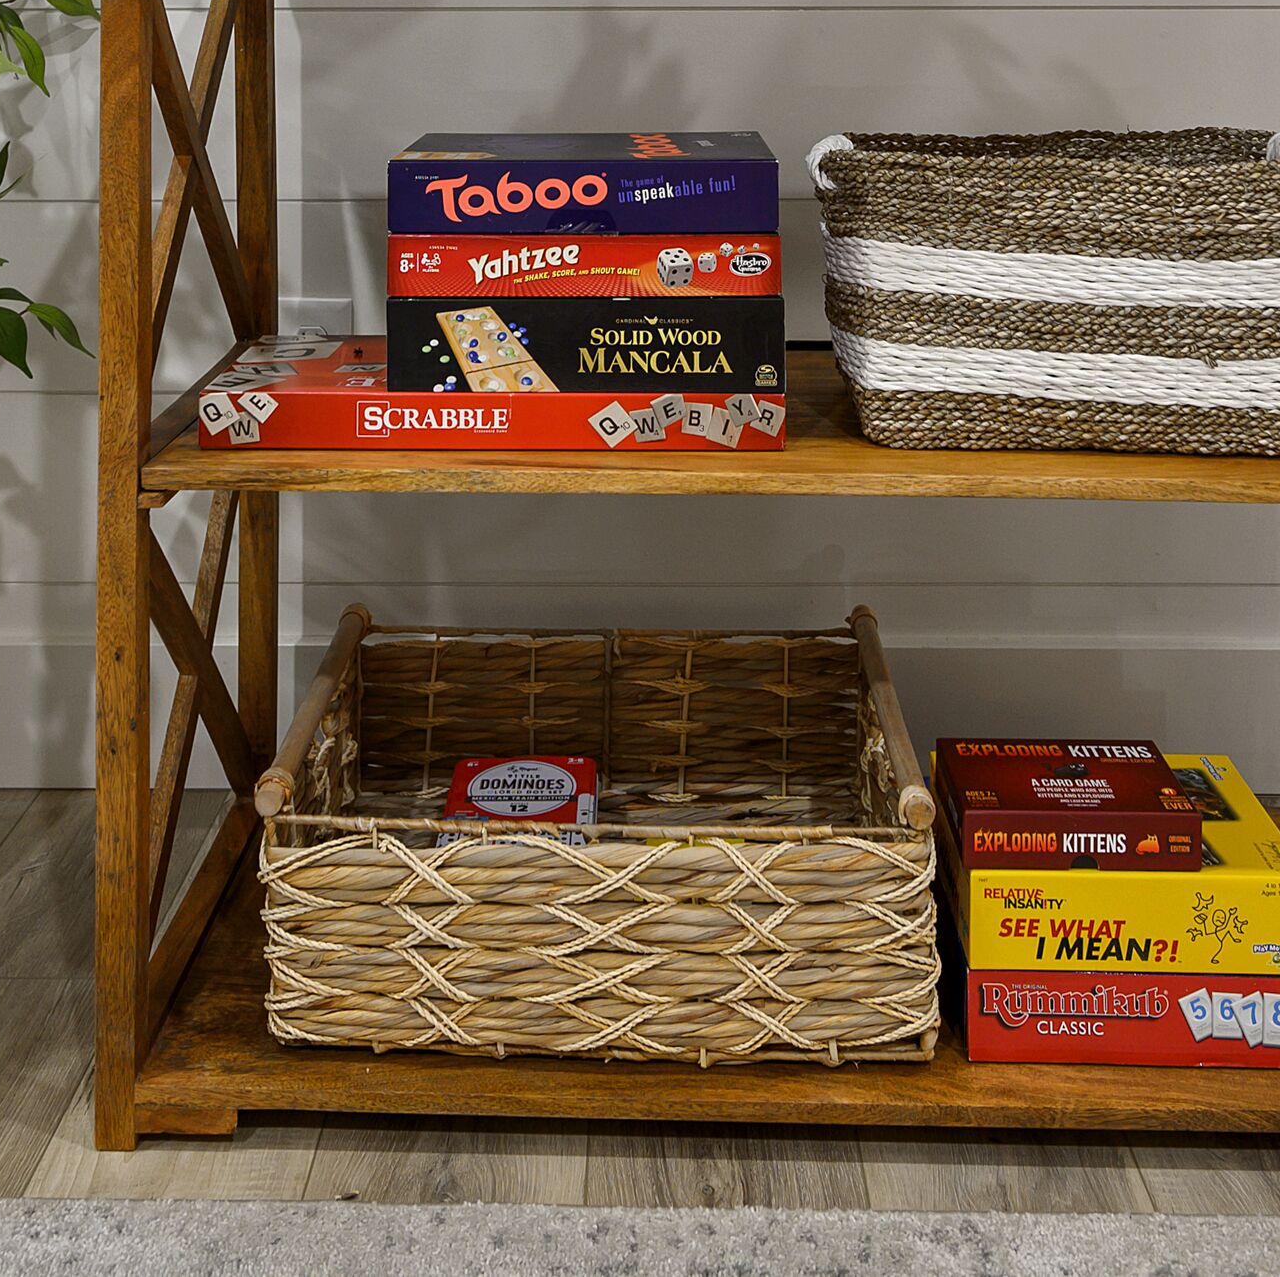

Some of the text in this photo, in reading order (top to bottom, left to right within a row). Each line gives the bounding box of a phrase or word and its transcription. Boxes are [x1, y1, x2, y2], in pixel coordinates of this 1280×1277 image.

[618, 175, 736, 204] unspeakable fun!
[621, 175, 664, 188] The game of
[425, 171, 608, 223] Taboo
[400, 259, 415, 273] 8+
[467, 244, 580, 285] Yahtzee
[731, 256, 768, 268] Hasbro
[524, 271, 550, 283] SHAKE,
[552, 268, 577, 278] SCORE,
[590, 267, 615, 275] SHOUT
[617, 267, 640, 276] GAME!
[590, 327, 722, 346] SOLID WOOD
[577, 347, 734, 374] MANCALA
[249, 394, 267, 411] E
[663, 401, 677, 419] E
[732, 399, 746, 416] Y
[203, 402, 223, 423] Q
[363, 406, 510, 431] SCRABBLE
[688, 410, 701, 426] B
[760, 408, 774, 426] R
[231, 419, 251, 437] W
[599, 416, 620, 436] Q
[634, 416, 656, 435] W
[956, 743, 1152, 759] EXPLODING KITTENS
[480, 778, 565, 790] DOMINOES
[1031, 778, 1111, 788] A CARD GAME
[510, 804, 528, 813] 12
[1163, 802, 1193, 810] EVER
[973, 829, 1127, 854] EXPLODING KITTENS
[1169, 835, 1192, 843] ORIGINAL
[1170, 845, 1190, 853] EDITION
[984, 888, 1044, 900] RELATIVE
[998, 918, 1126, 939] SEE WHAT
[1036, 936, 1179, 963] I MEAN?!
[982, 982, 1170, 1028] Rummikub
[1189, 997, 1207, 1020] 5
[1220, 998, 1234, 1021] 6
[1242, 1001, 1257, 1025] 7
[1036, 1020, 1105, 1036] CLASSIC
